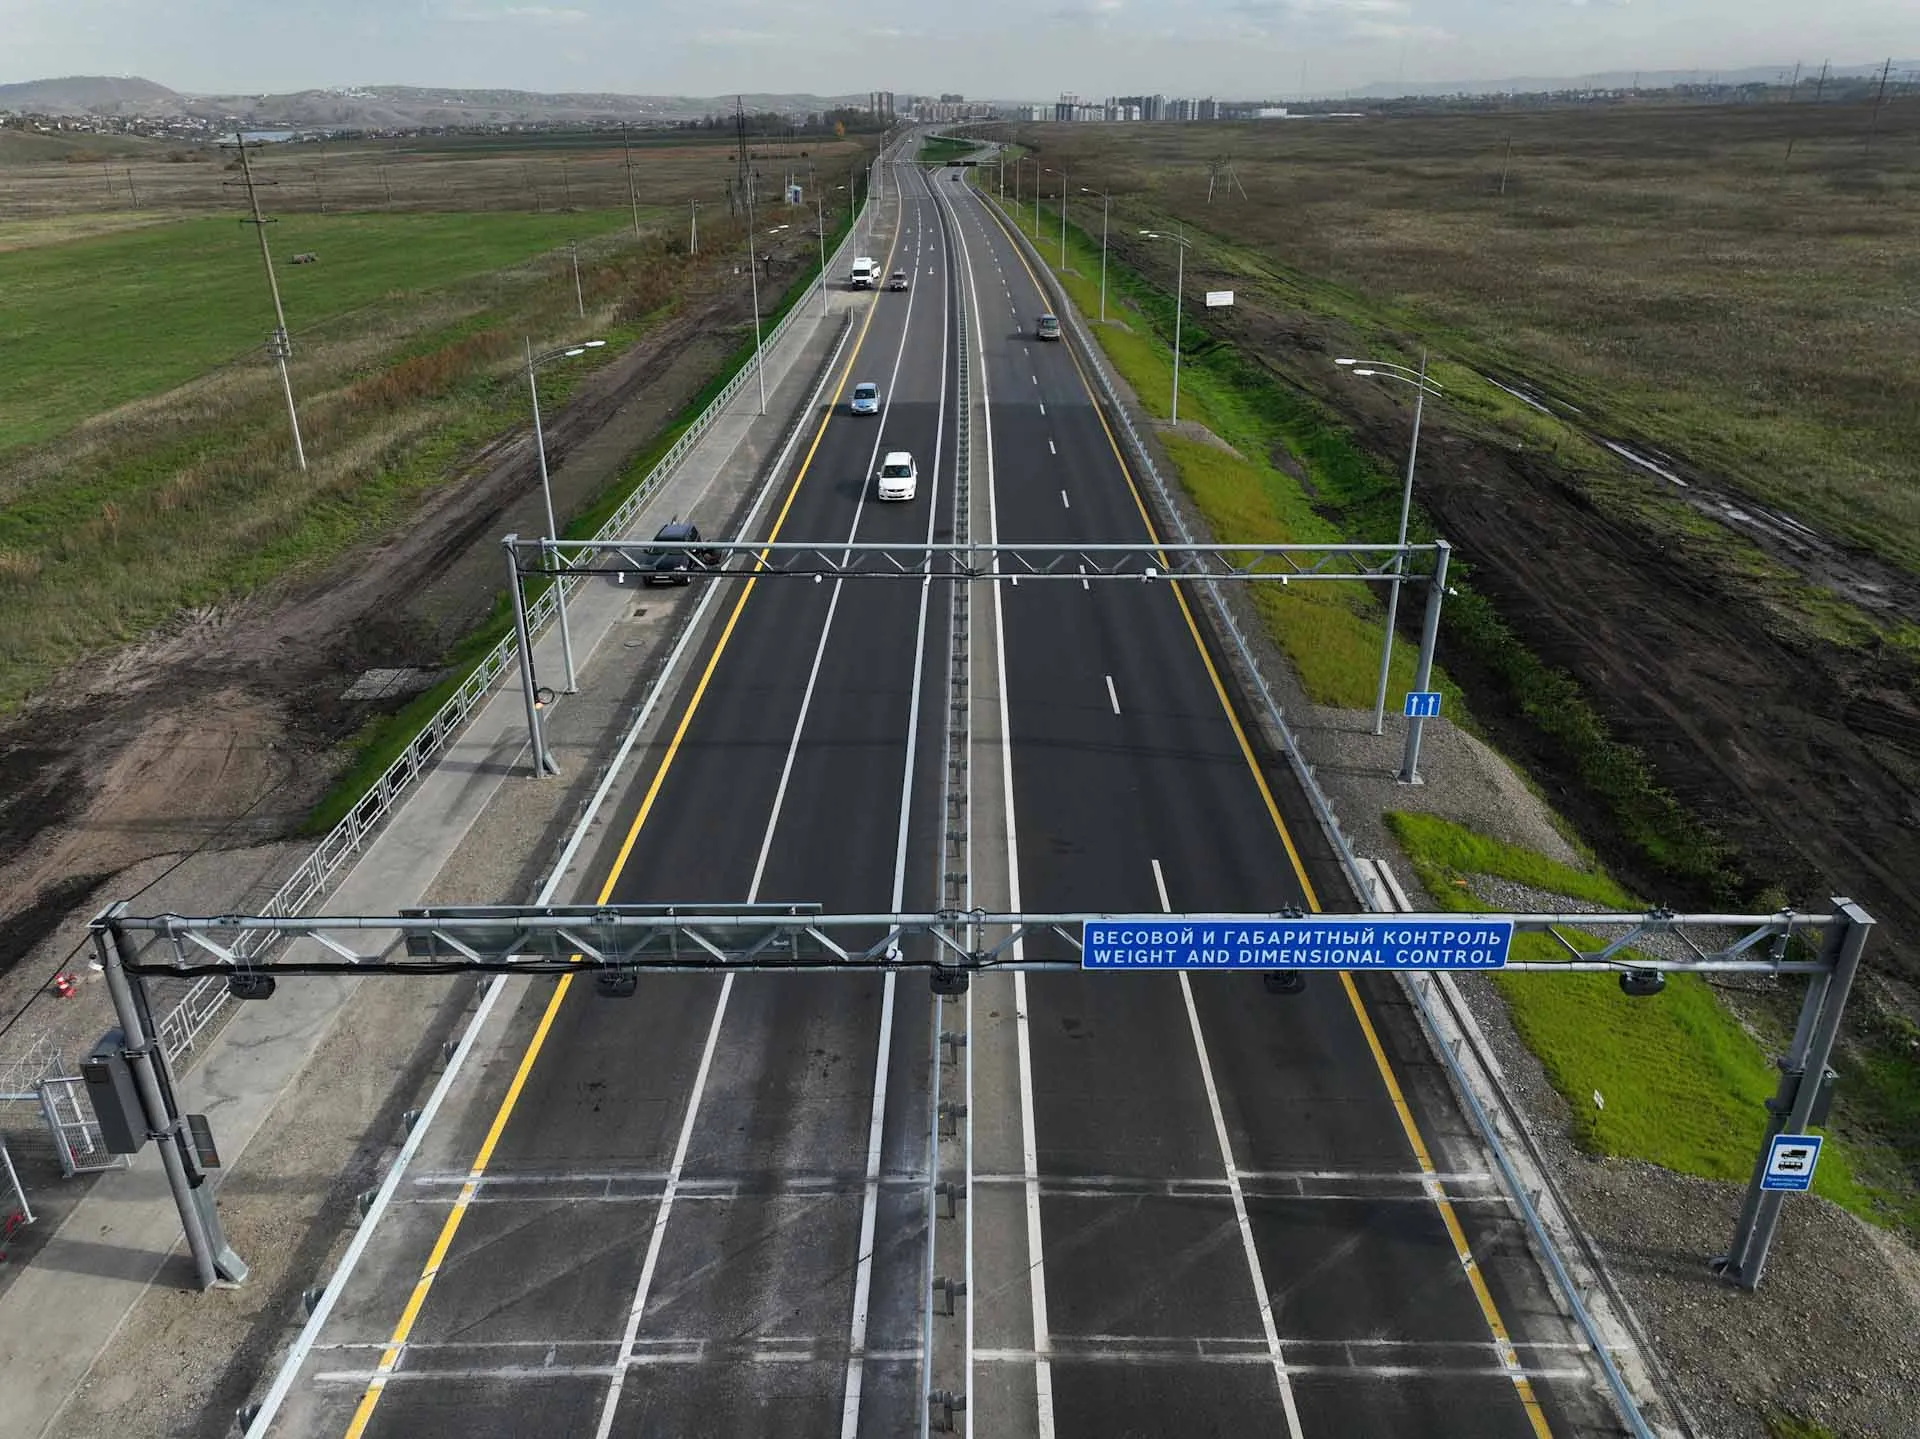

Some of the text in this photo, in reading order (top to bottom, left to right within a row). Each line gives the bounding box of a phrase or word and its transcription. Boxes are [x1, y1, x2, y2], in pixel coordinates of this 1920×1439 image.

[1093, 927, 1501, 945] ВЕСОВОЙ И ГАБАРИТНЫЙ КОНТРОЛЬ
[1094, 949, 1496, 964] WEIGHT AND DIMENSIONAL CONTROL
